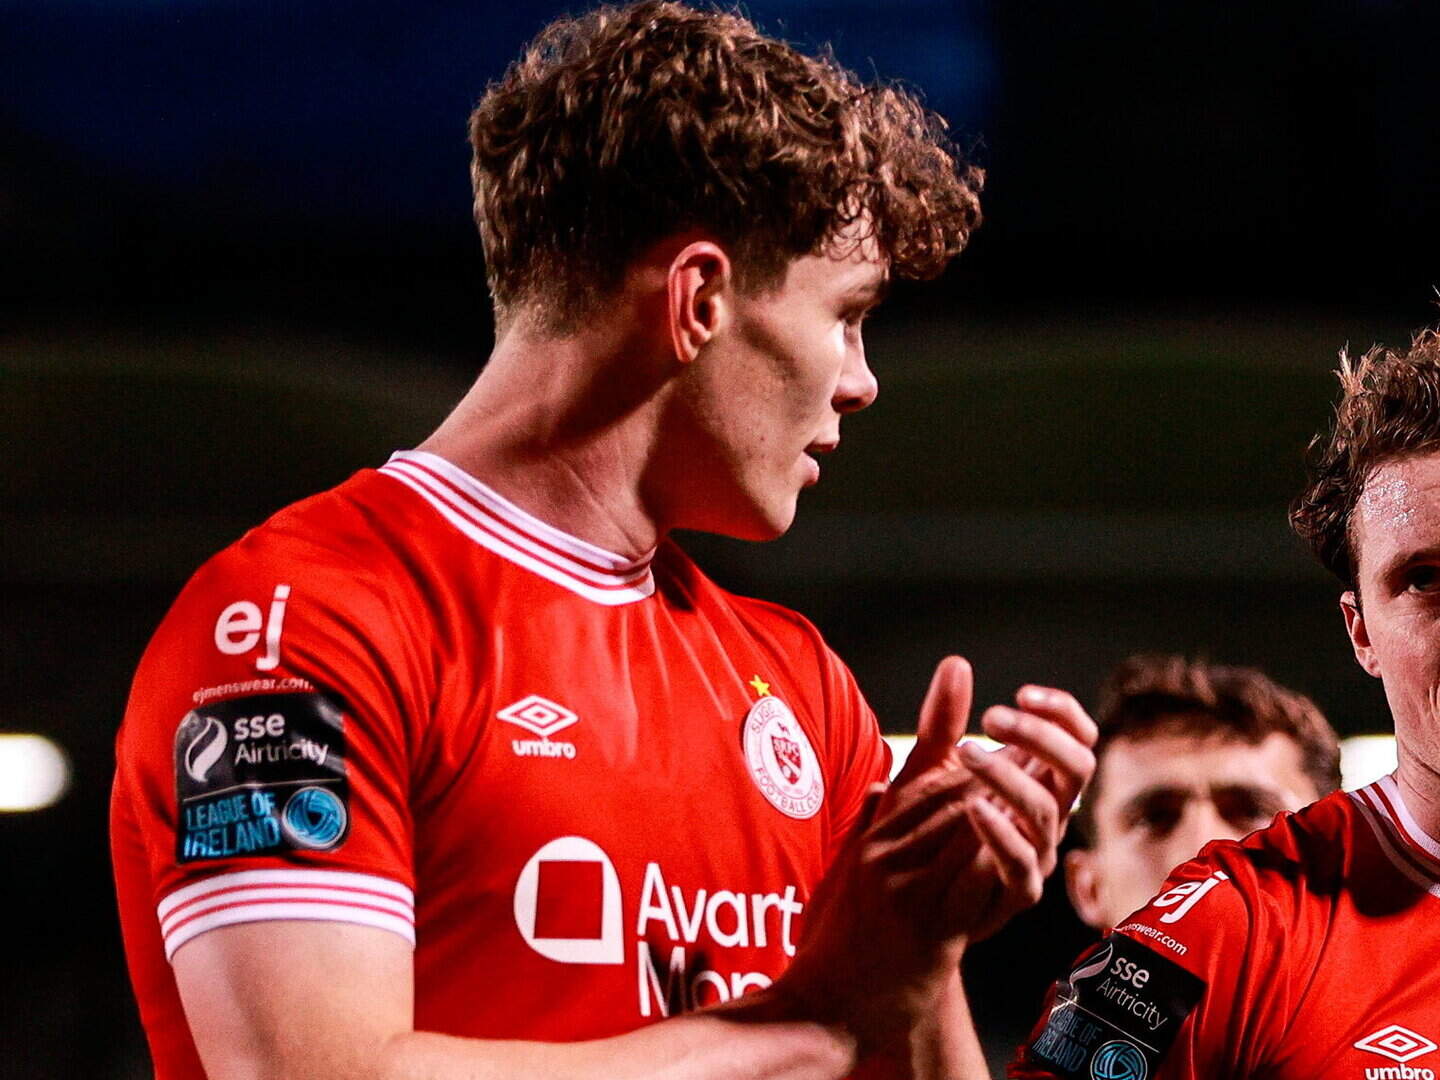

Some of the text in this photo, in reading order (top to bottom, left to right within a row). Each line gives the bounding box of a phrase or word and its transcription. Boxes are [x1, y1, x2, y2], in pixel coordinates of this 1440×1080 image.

[214, 584, 291, 671] ej
[234, 713, 286, 741] sse
[234, 737, 329, 767] Airtricity
[511, 738, 577, 760] umbro
[185, 789, 276, 832] LEAGUE OF
[183, 817, 281, 857] IRELAND
[1152, 870, 1230, 924] ej
[1110, 956, 1150, 989] sse
[1096, 976, 1168, 1031] Airtricity
